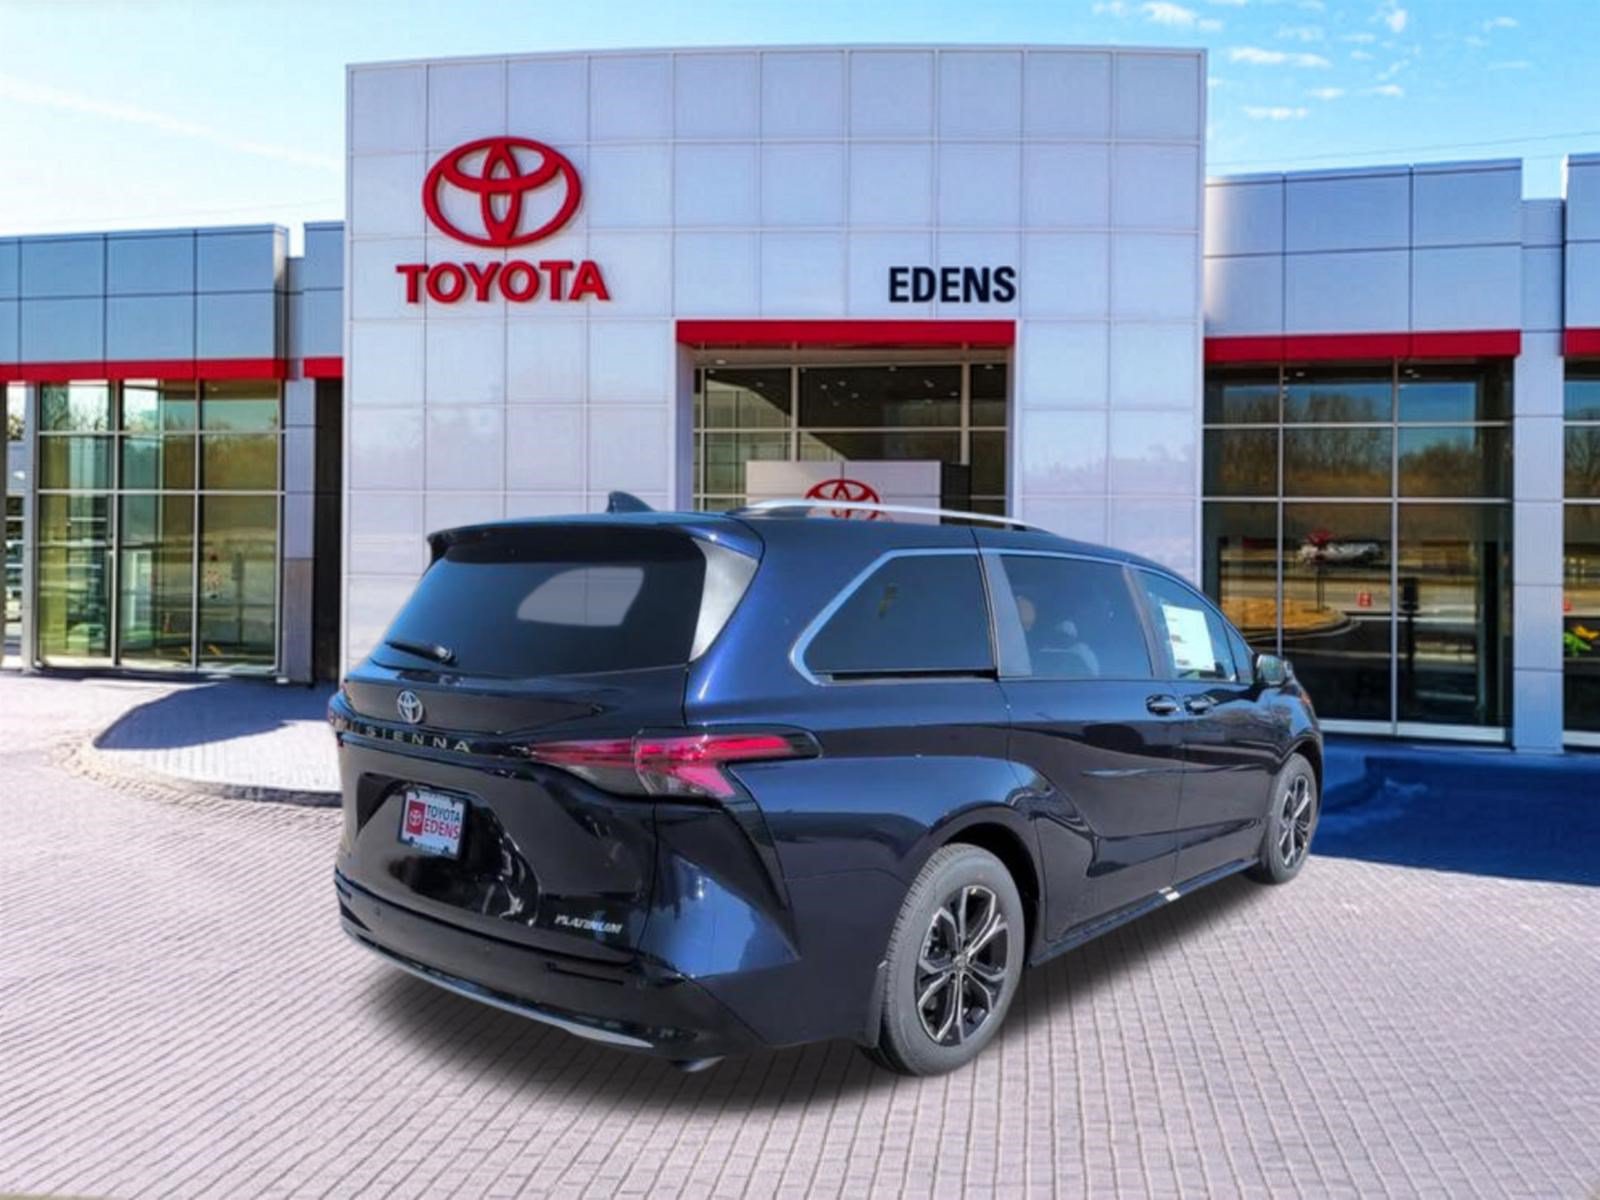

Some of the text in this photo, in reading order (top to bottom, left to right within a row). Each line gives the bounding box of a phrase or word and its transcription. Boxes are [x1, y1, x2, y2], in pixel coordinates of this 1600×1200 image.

[395, 260, 611, 304] TOYOTA
[889, 266, 1016, 303] EDENS
[365, 726, 471, 753] SIENNA
[427, 804, 460, 822] TOYOTA
[424, 818, 460, 840] EDENS
